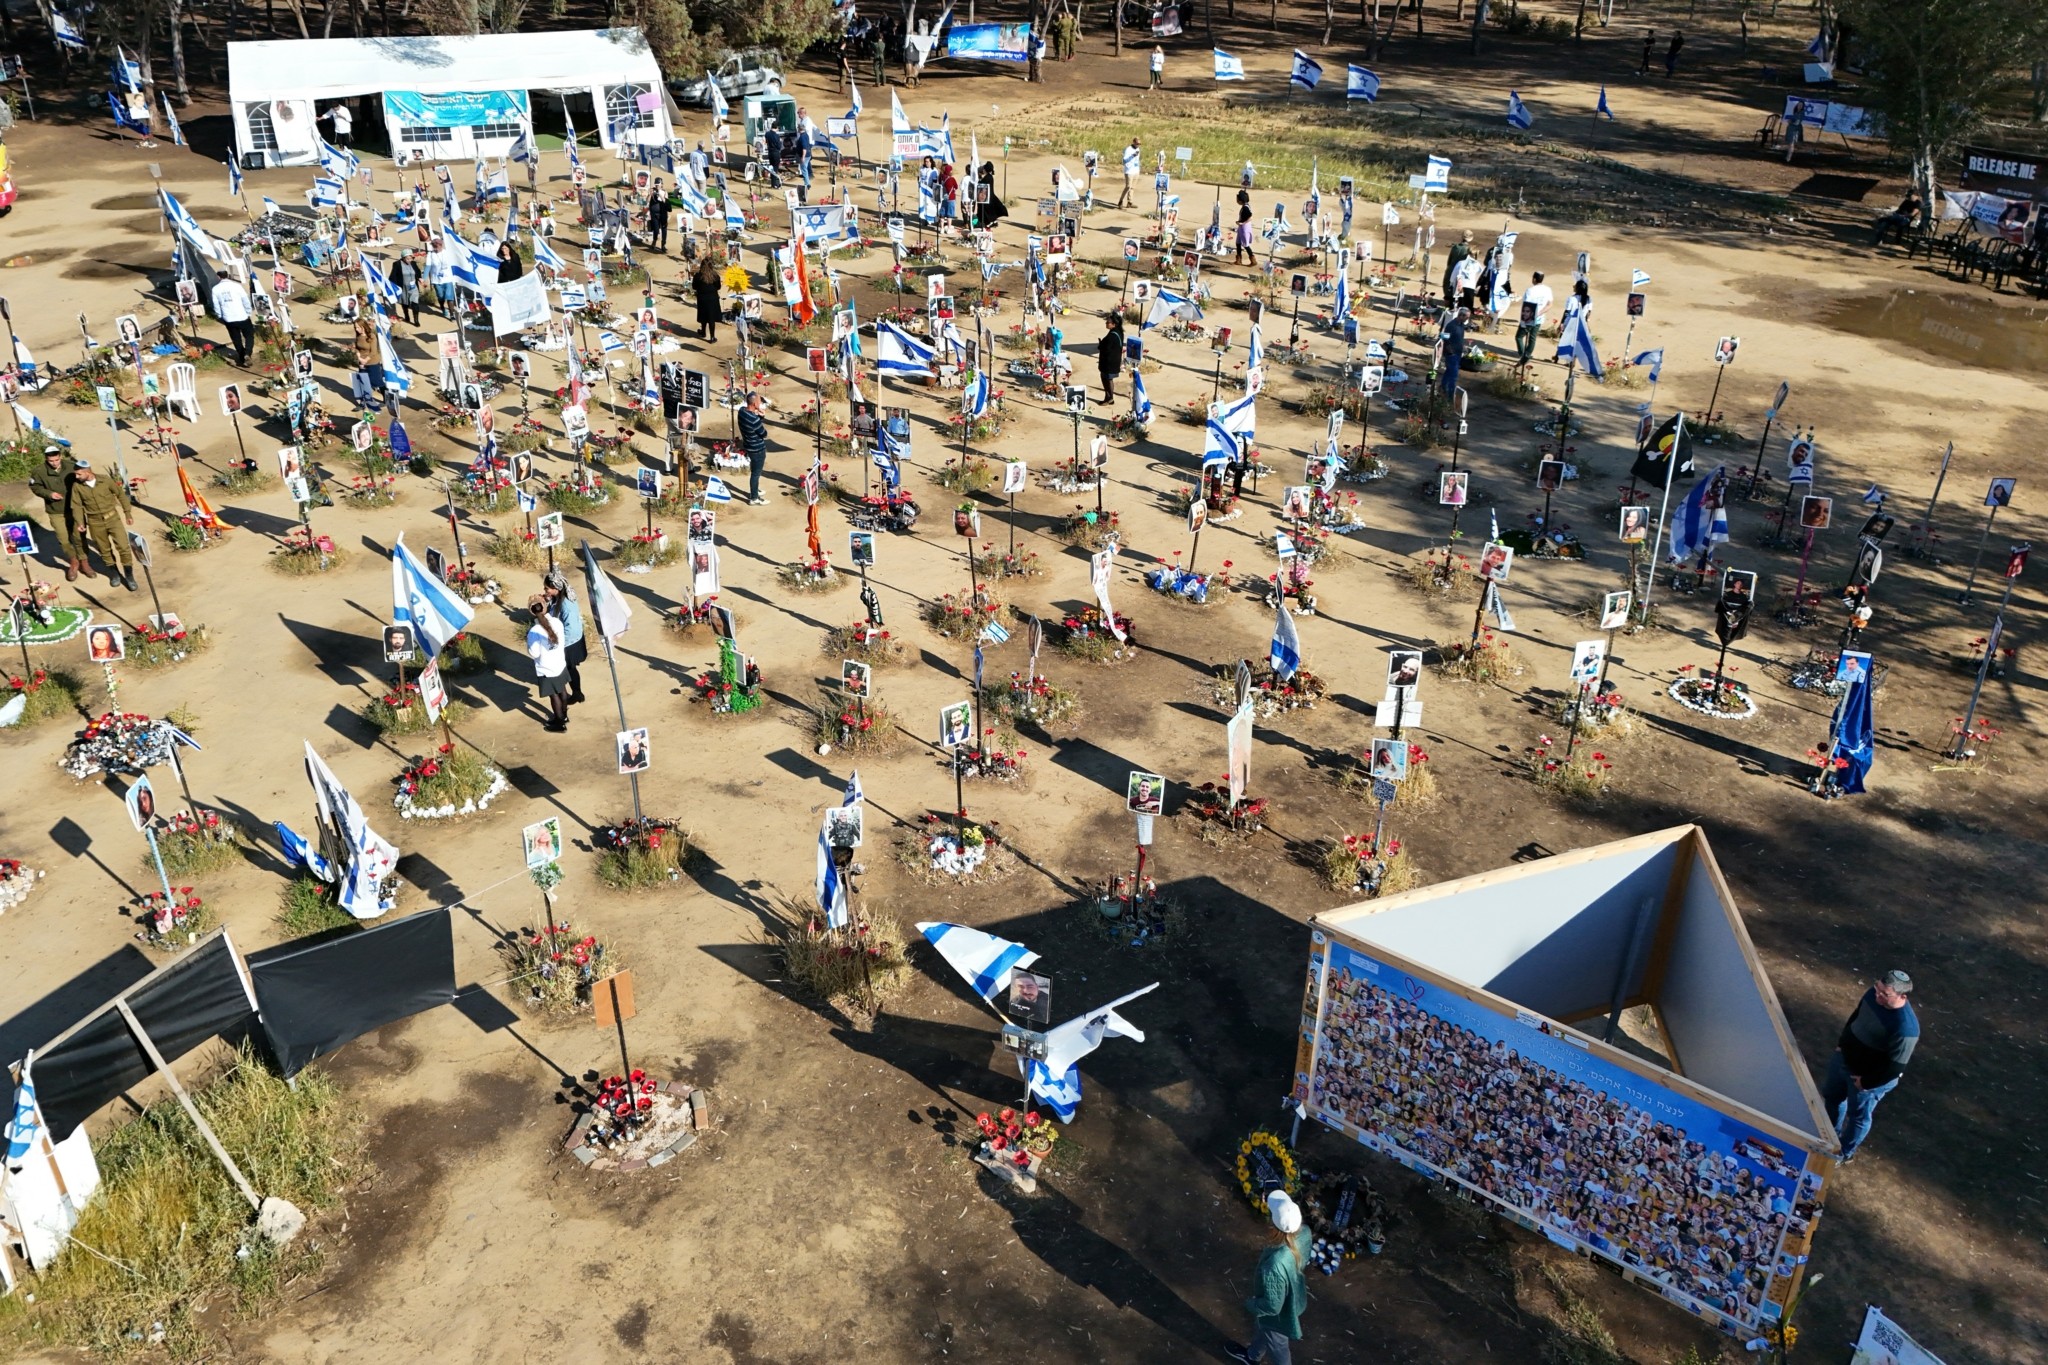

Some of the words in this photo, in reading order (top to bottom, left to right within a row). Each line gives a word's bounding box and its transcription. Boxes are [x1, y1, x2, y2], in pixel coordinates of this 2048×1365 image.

[1968, 155, 2018, 177] RELEASE
[2018, 163, 2037, 180] ME
[1568, 1061, 1583, 1072] עם
[1625, 1085, 1652, 1104] נזכור
[1656, 1101, 1684, 1118] לנצח
